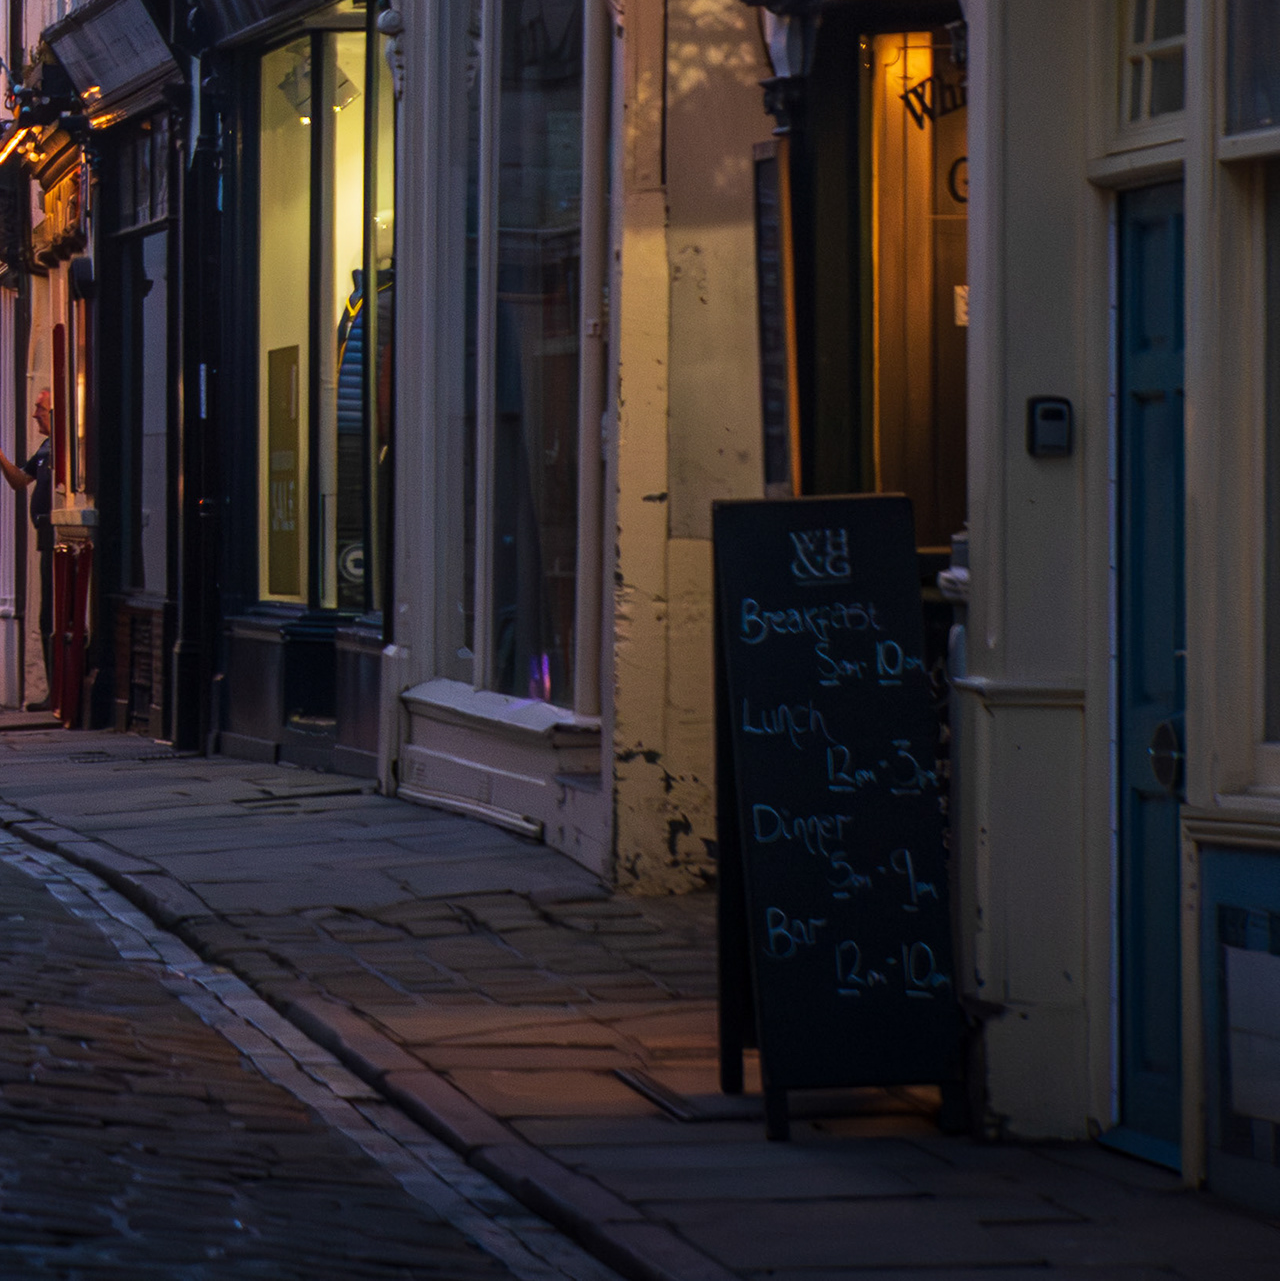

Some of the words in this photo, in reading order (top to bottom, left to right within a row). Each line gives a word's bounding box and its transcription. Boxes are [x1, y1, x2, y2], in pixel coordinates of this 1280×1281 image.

[740, 597, 881, 645] Breakfast
[743, 696, 839, 750] Lunch
[752, 802, 854, 858] Dinner
[762, 906, 828, 959] Bar
